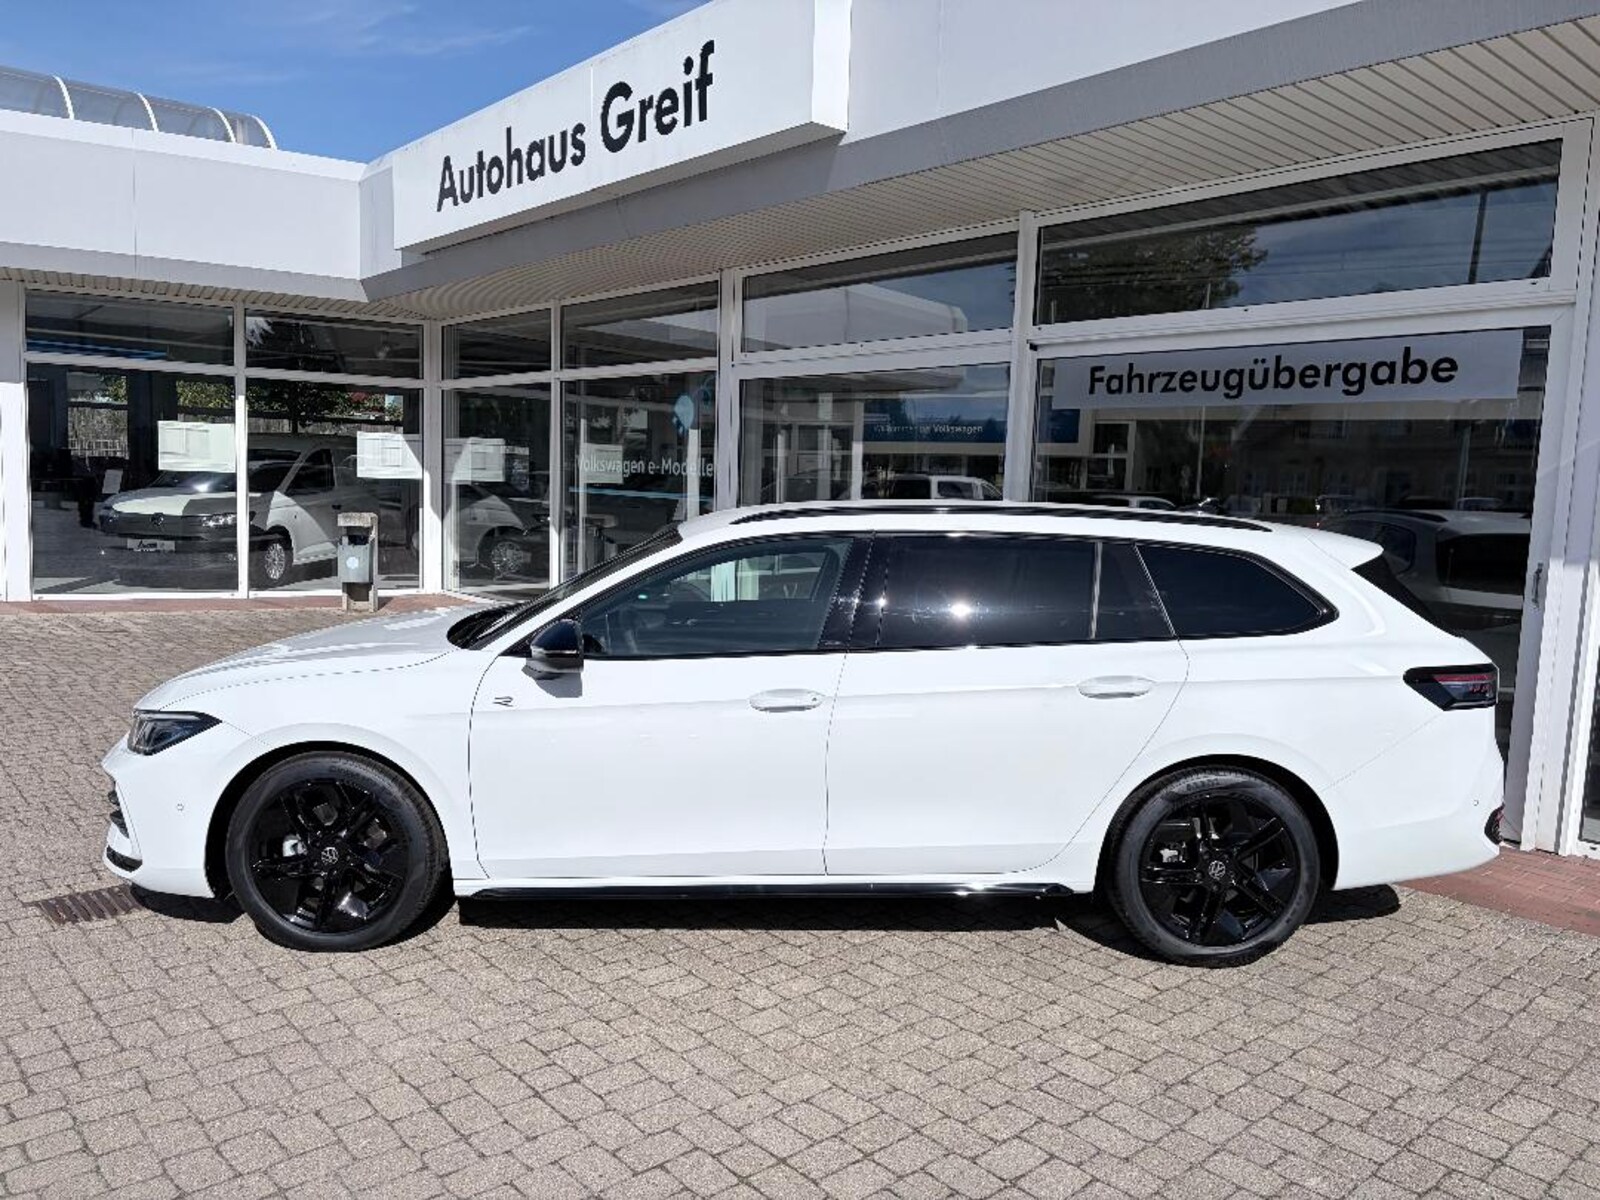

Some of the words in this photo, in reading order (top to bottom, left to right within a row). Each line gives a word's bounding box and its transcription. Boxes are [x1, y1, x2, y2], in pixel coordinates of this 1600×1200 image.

[436, 122, 586, 213] Autohaus
[600, 39, 715, 153] Greif
[1088, 346, 1459, 399] Fahrzeugübergabe
[578, 455, 645, 477] Volkswagen
